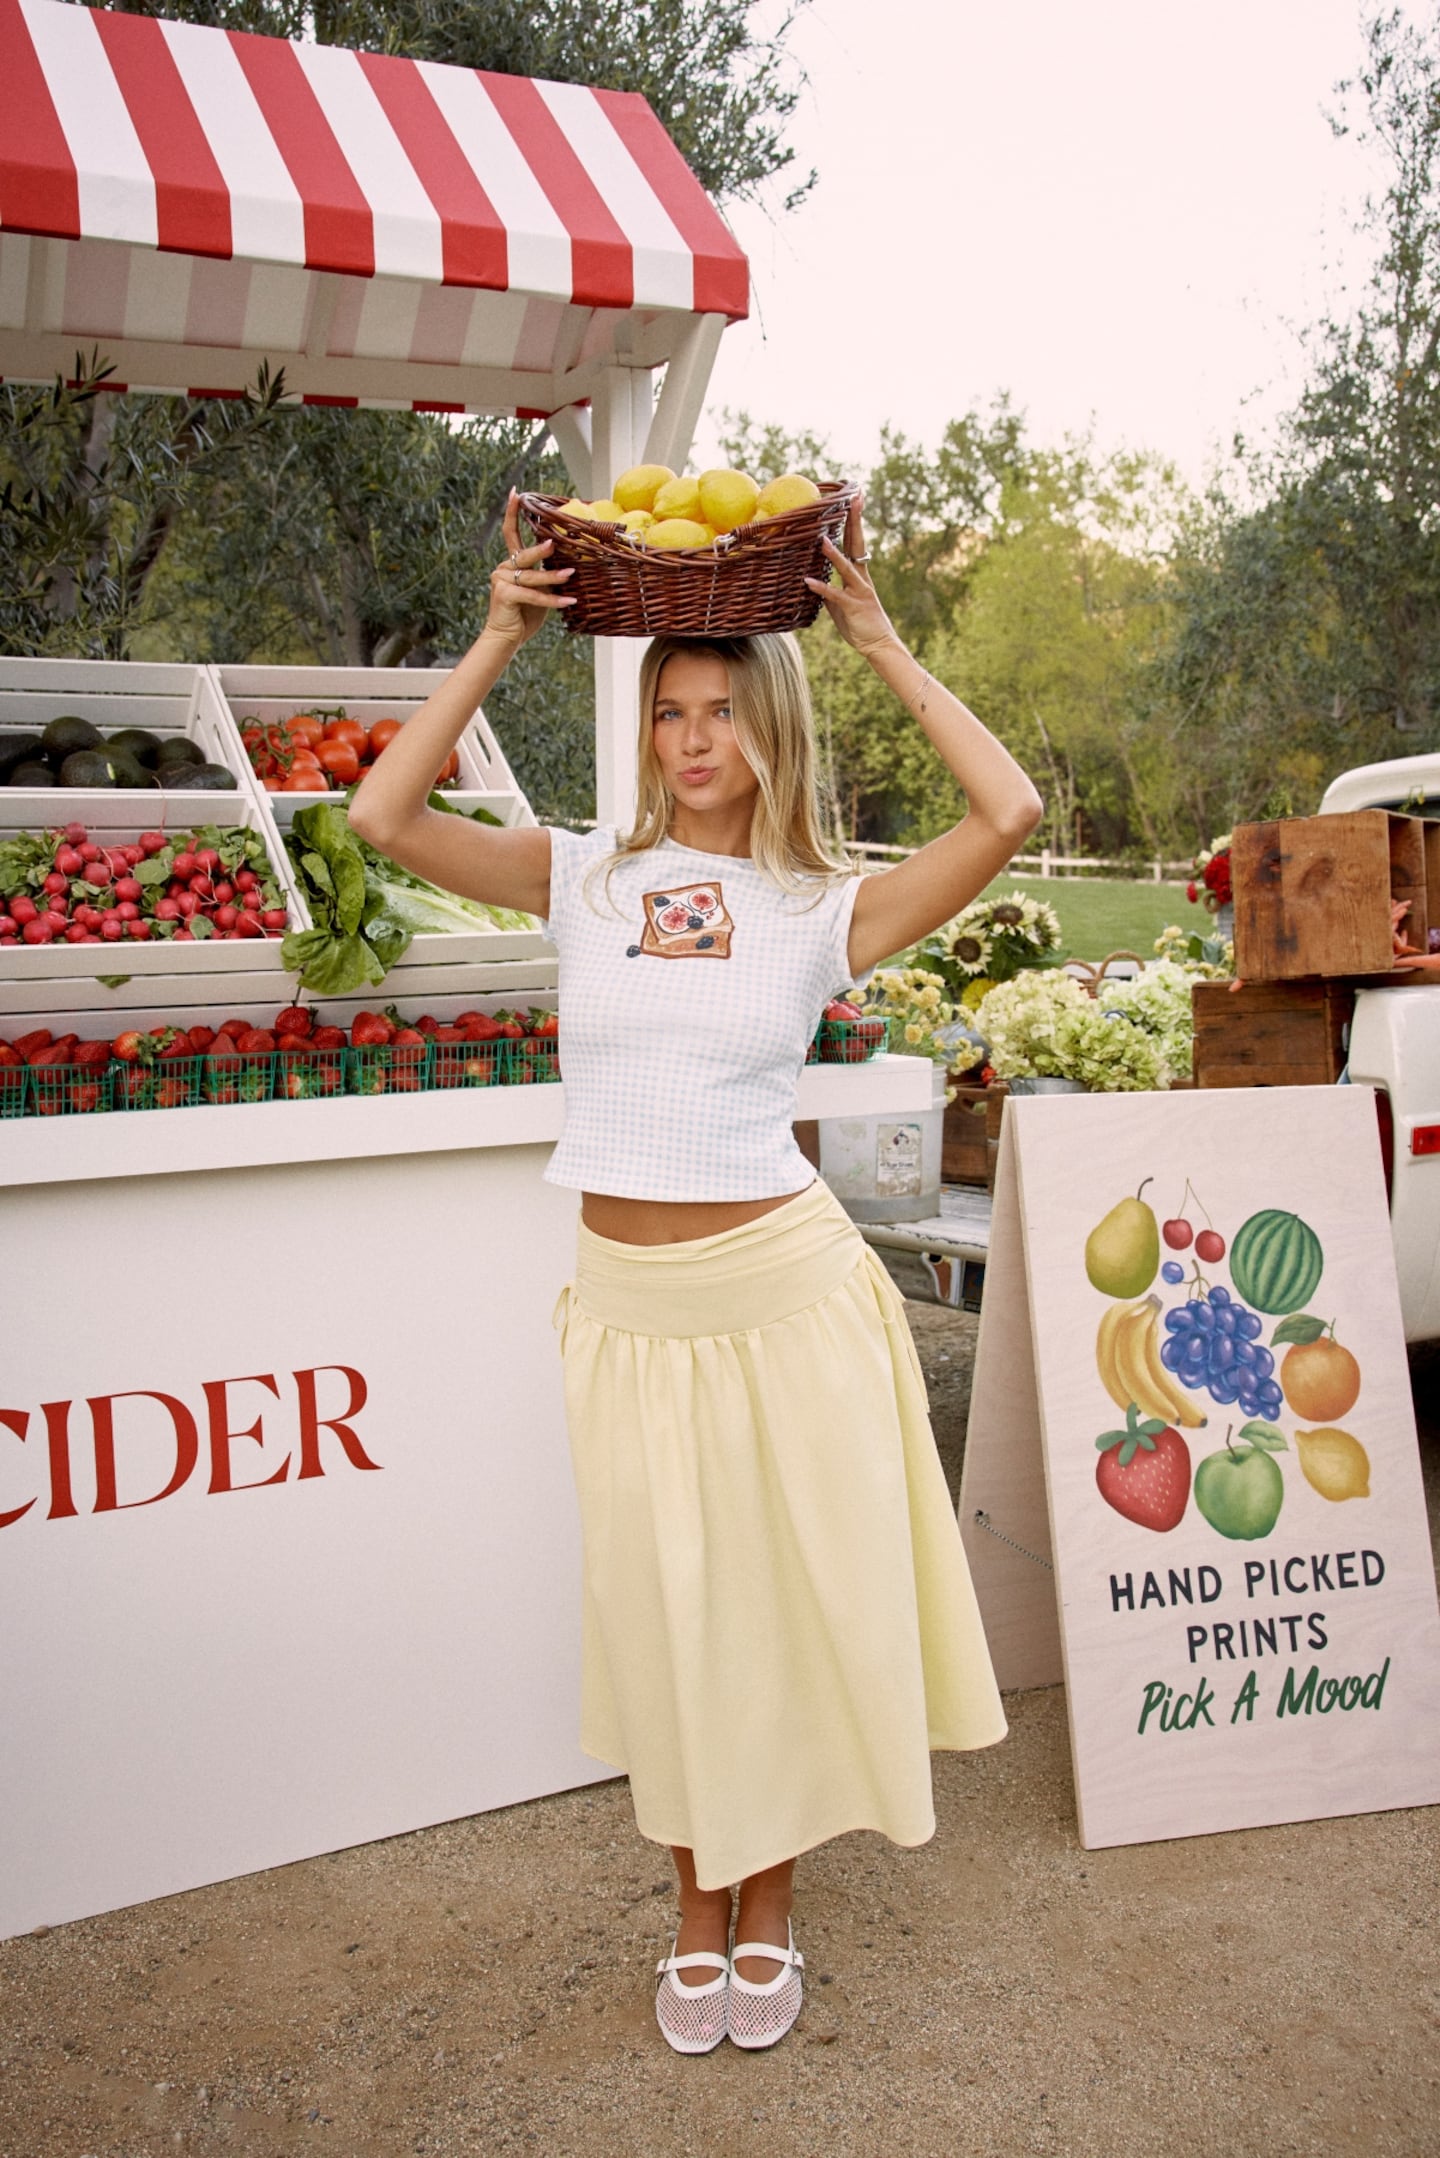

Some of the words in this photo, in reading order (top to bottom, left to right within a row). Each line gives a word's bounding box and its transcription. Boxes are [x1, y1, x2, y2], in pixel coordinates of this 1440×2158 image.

[1110, 1566, 1222, 1612] HAND
[1244, 1550, 1385, 1598] PICKED
[1187, 1612, 1328, 1663] PRINTS
[1138, 1677, 1215, 1735] Pick
[1231, 1670, 1259, 1724] A
[1277, 1657, 1390, 1718] Mood
